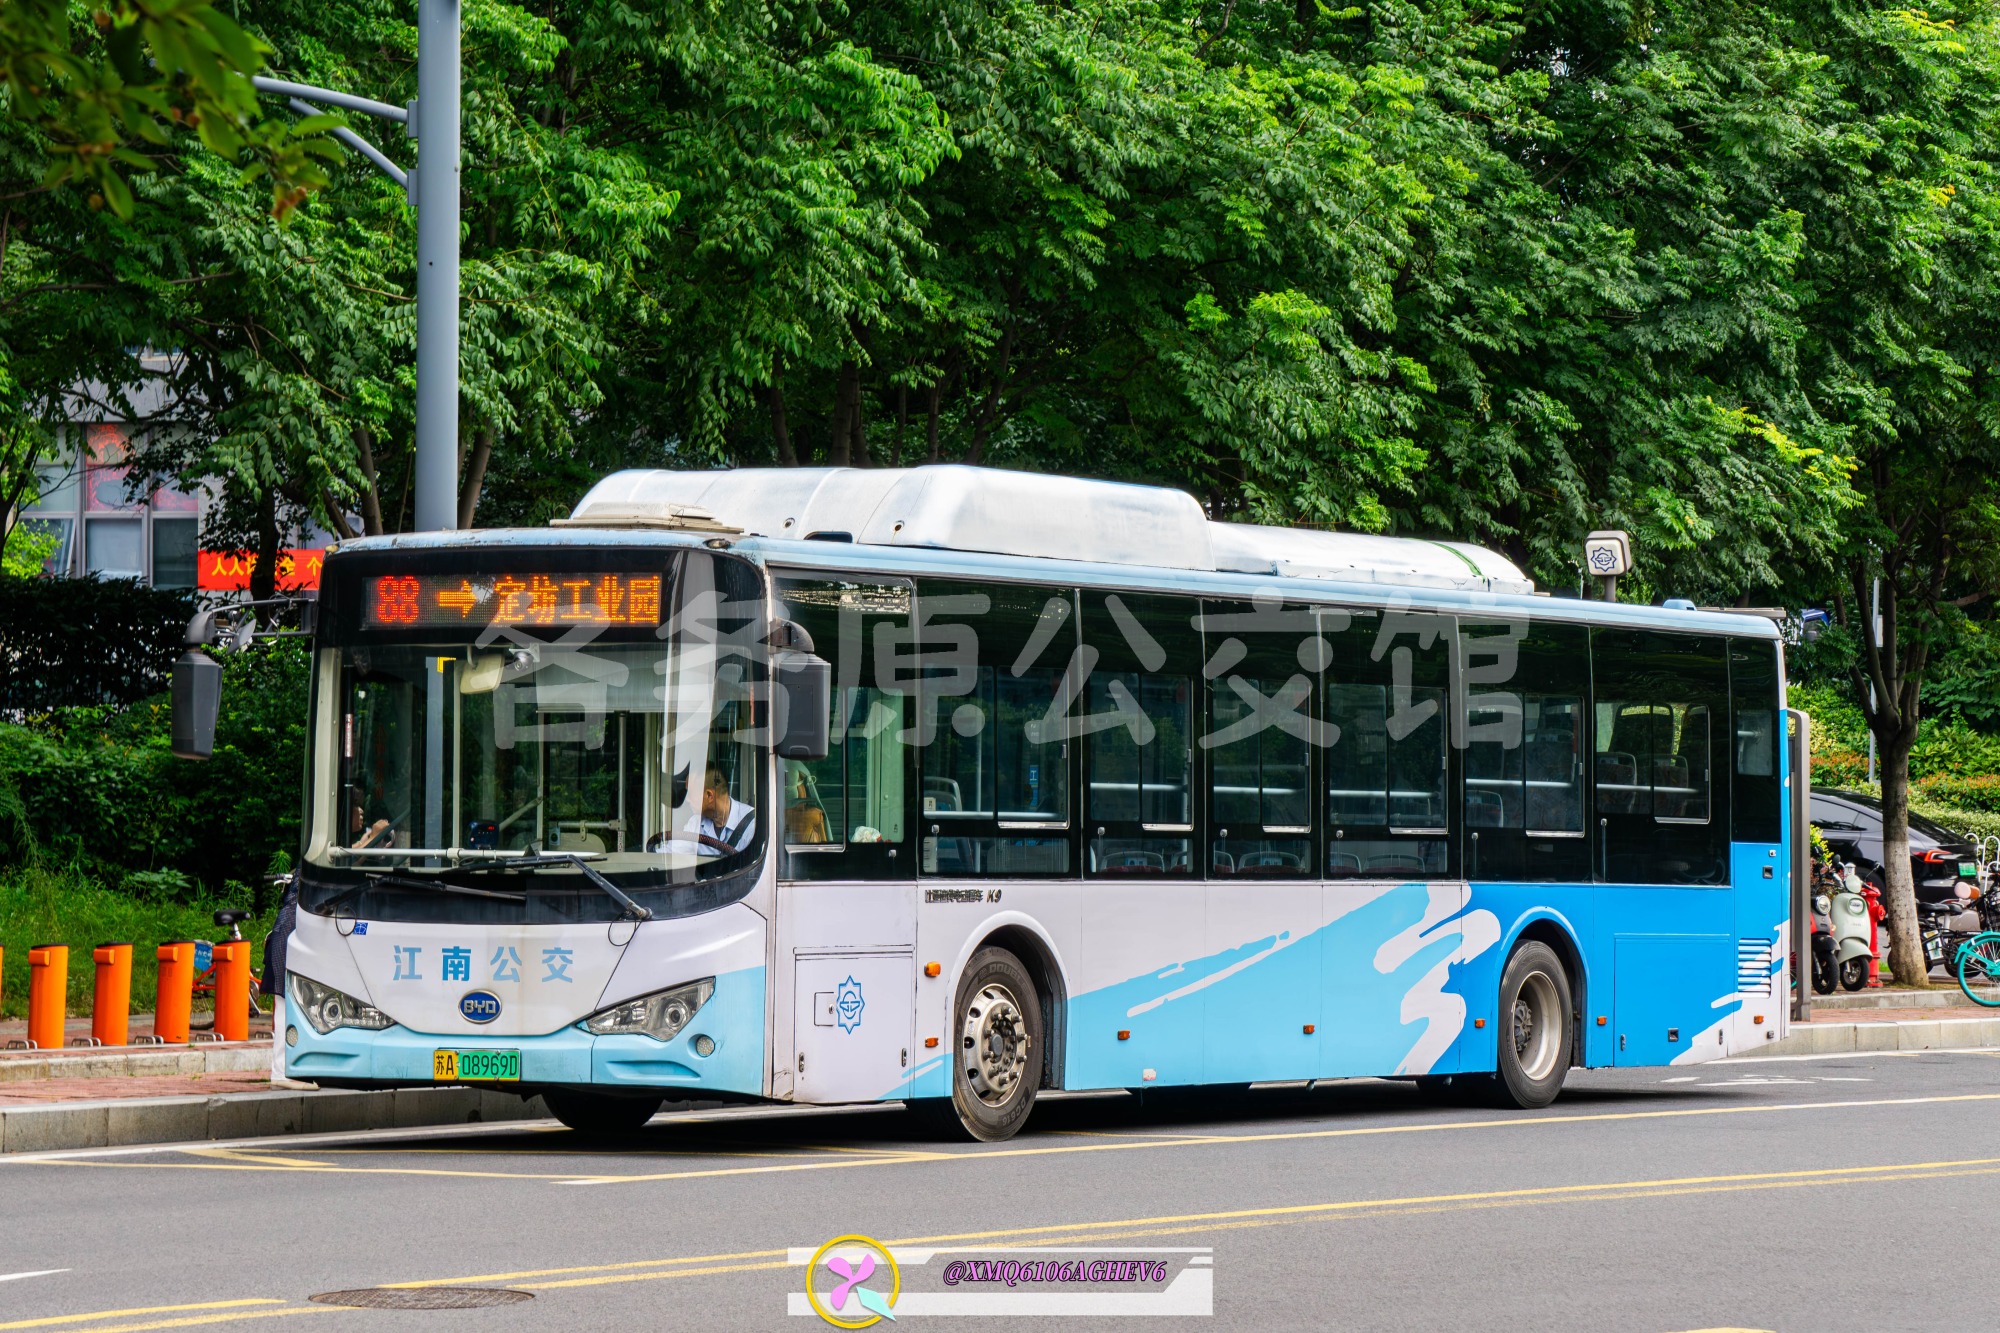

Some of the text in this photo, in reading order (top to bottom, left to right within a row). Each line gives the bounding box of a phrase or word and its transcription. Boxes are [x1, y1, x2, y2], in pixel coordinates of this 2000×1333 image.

[378, 576, 660, 623] 88 定坊工业园
[393, 945, 574, 983] 江南公交
[463, 999, 497, 1014] BYD
